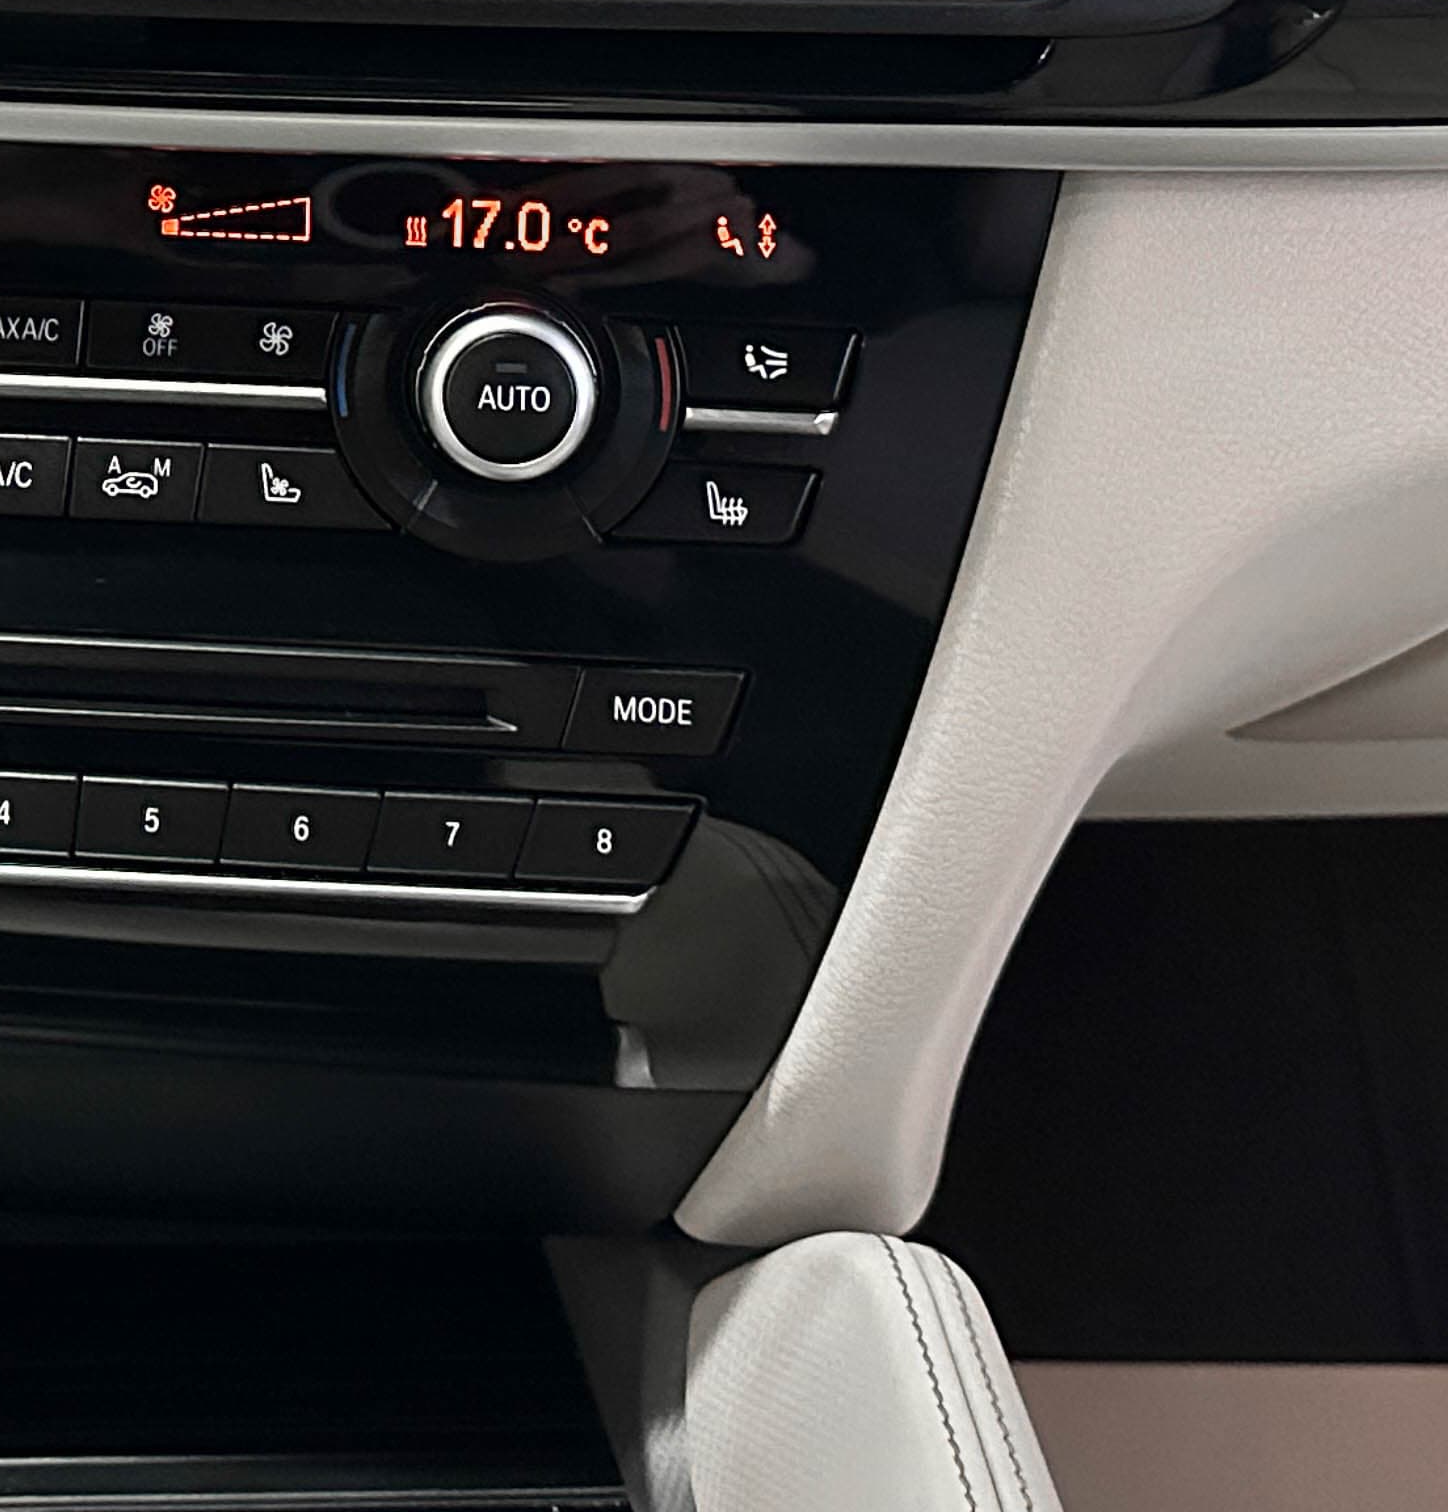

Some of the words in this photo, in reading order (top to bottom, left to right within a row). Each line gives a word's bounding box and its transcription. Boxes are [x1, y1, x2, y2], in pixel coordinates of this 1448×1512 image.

[441, 198, 551, 252] 17.0
[142, 338, 178, 357] OFF
[477, 384, 551, 412] AUTO
[107, 455, 122, 474] A
[152, 457, 172, 478] M
[613, 695, 693, 725] MODE
[144, 807, 160, 833] 5
[293, 815, 310, 842] 6
[445, 821, 460, 847] 7
[596, 828, 613, 854] 8
